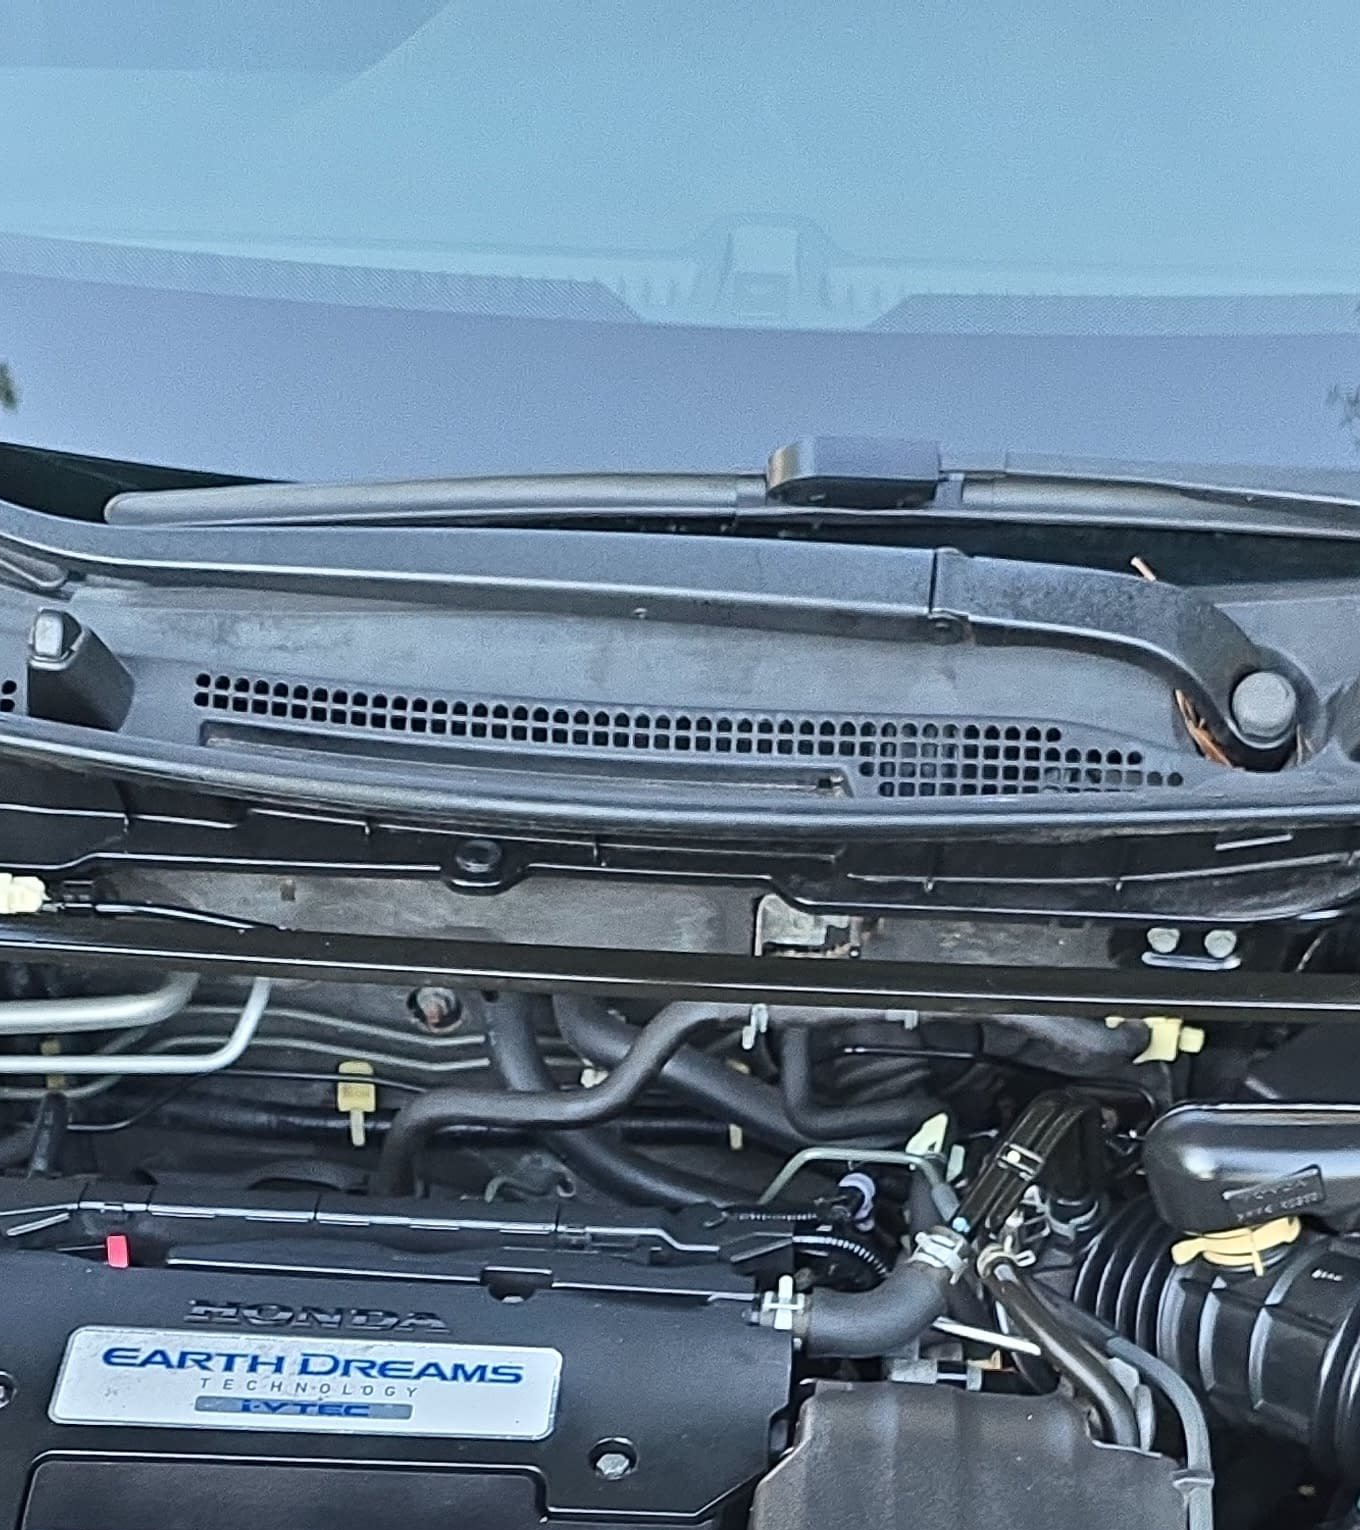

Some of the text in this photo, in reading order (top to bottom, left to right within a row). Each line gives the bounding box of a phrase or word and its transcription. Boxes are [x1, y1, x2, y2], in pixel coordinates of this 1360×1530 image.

[183, 1299, 451, 1334] HONDA
[102, 1346, 524, 1385] EARTH DREAMS
[199, 1377, 418, 1398] TECHNOLOGY
